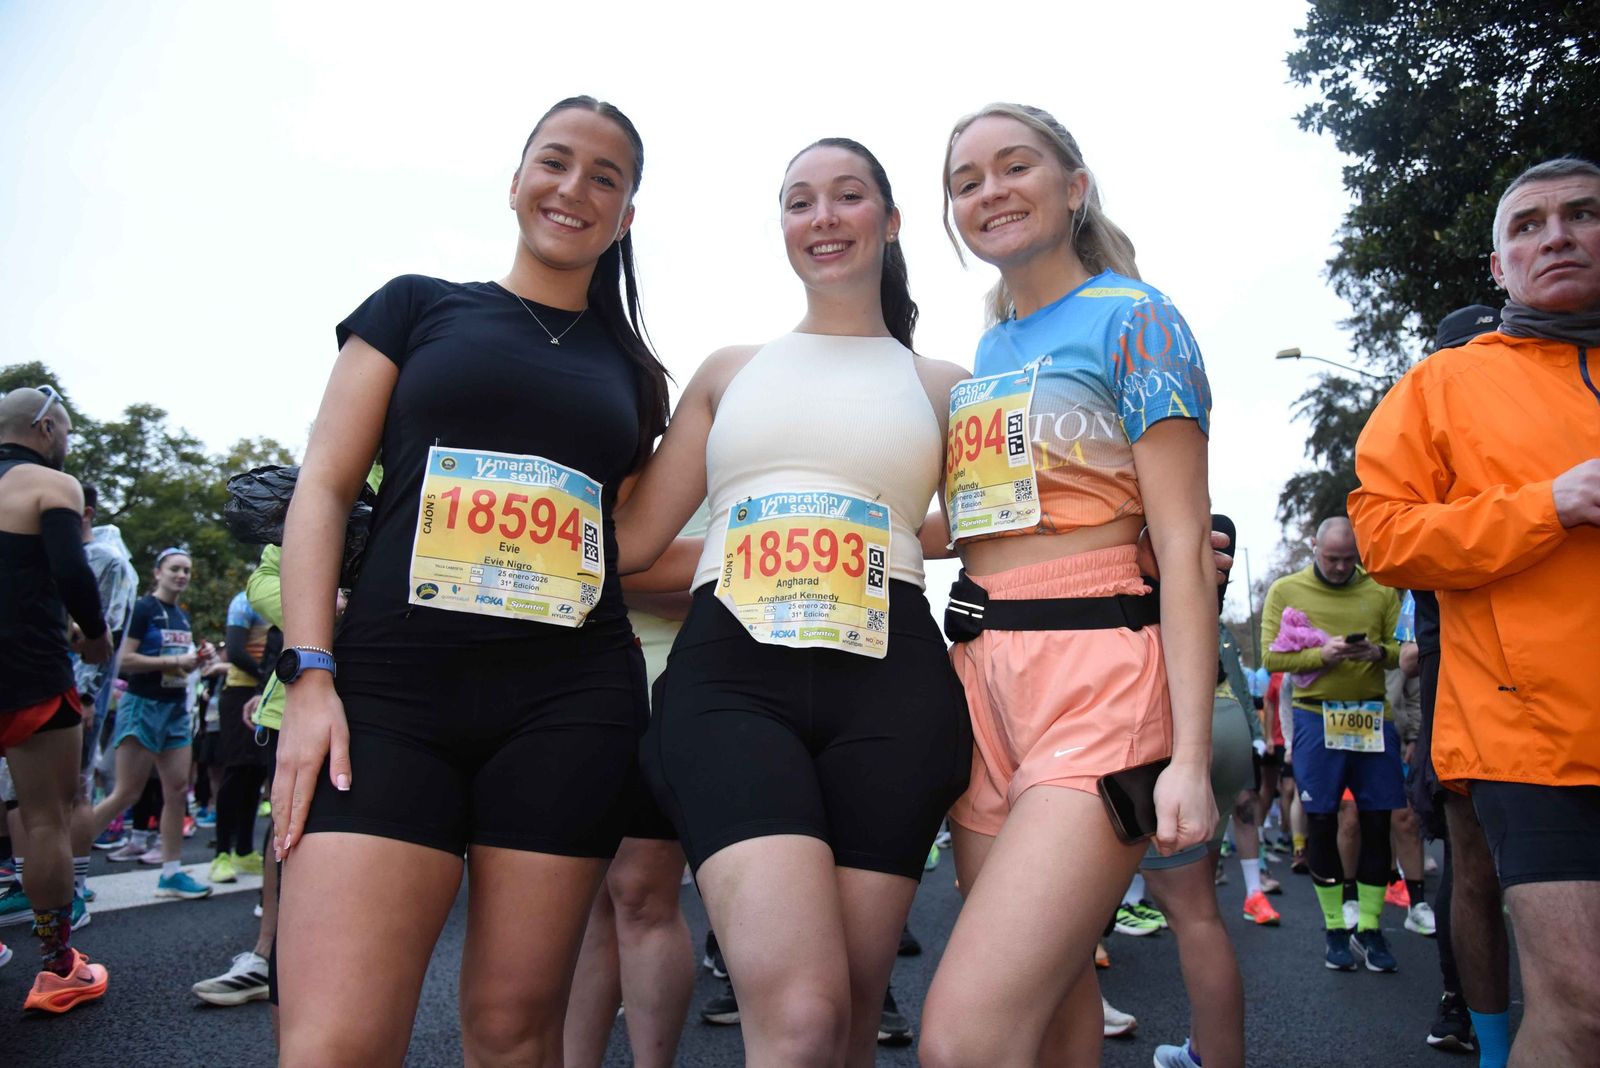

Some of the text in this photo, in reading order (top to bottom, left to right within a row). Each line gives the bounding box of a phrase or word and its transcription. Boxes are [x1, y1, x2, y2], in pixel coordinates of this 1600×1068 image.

[494, 459, 558, 477] maratón
[510, 471, 559, 486] sevilla
[776, 493, 838, 506] maratón
[790, 499, 838, 515] sevilla
[423, 501, 435, 535] CAJÓN
[440, 486, 582, 552] 18594
[499, 541, 521, 554] Evie
[736, 528, 866, 580] 18593
[484, 556, 533, 571] Evie Nigro
[498, 569, 549, 584] 25 enero 2026
[723, 560, 734, 588] CAJÓN
[513, 580, 540, 591] Edición
[776, 576, 819, 588] Angharad
[475, 594, 504, 607] HOKA
[758, 591, 840, 603] Angharad Kennedy
[511, 600, 545, 612] Sprinter
[788, 602, 797, 610] 25
[820, 603, 837, 611] 2026
[803, 611, 830, 619] Edición
[770, 630, 797, 638] HOKA
[803, 629, 836, 638] Sprinter
[1330, 712, 1373, 729] 17800
